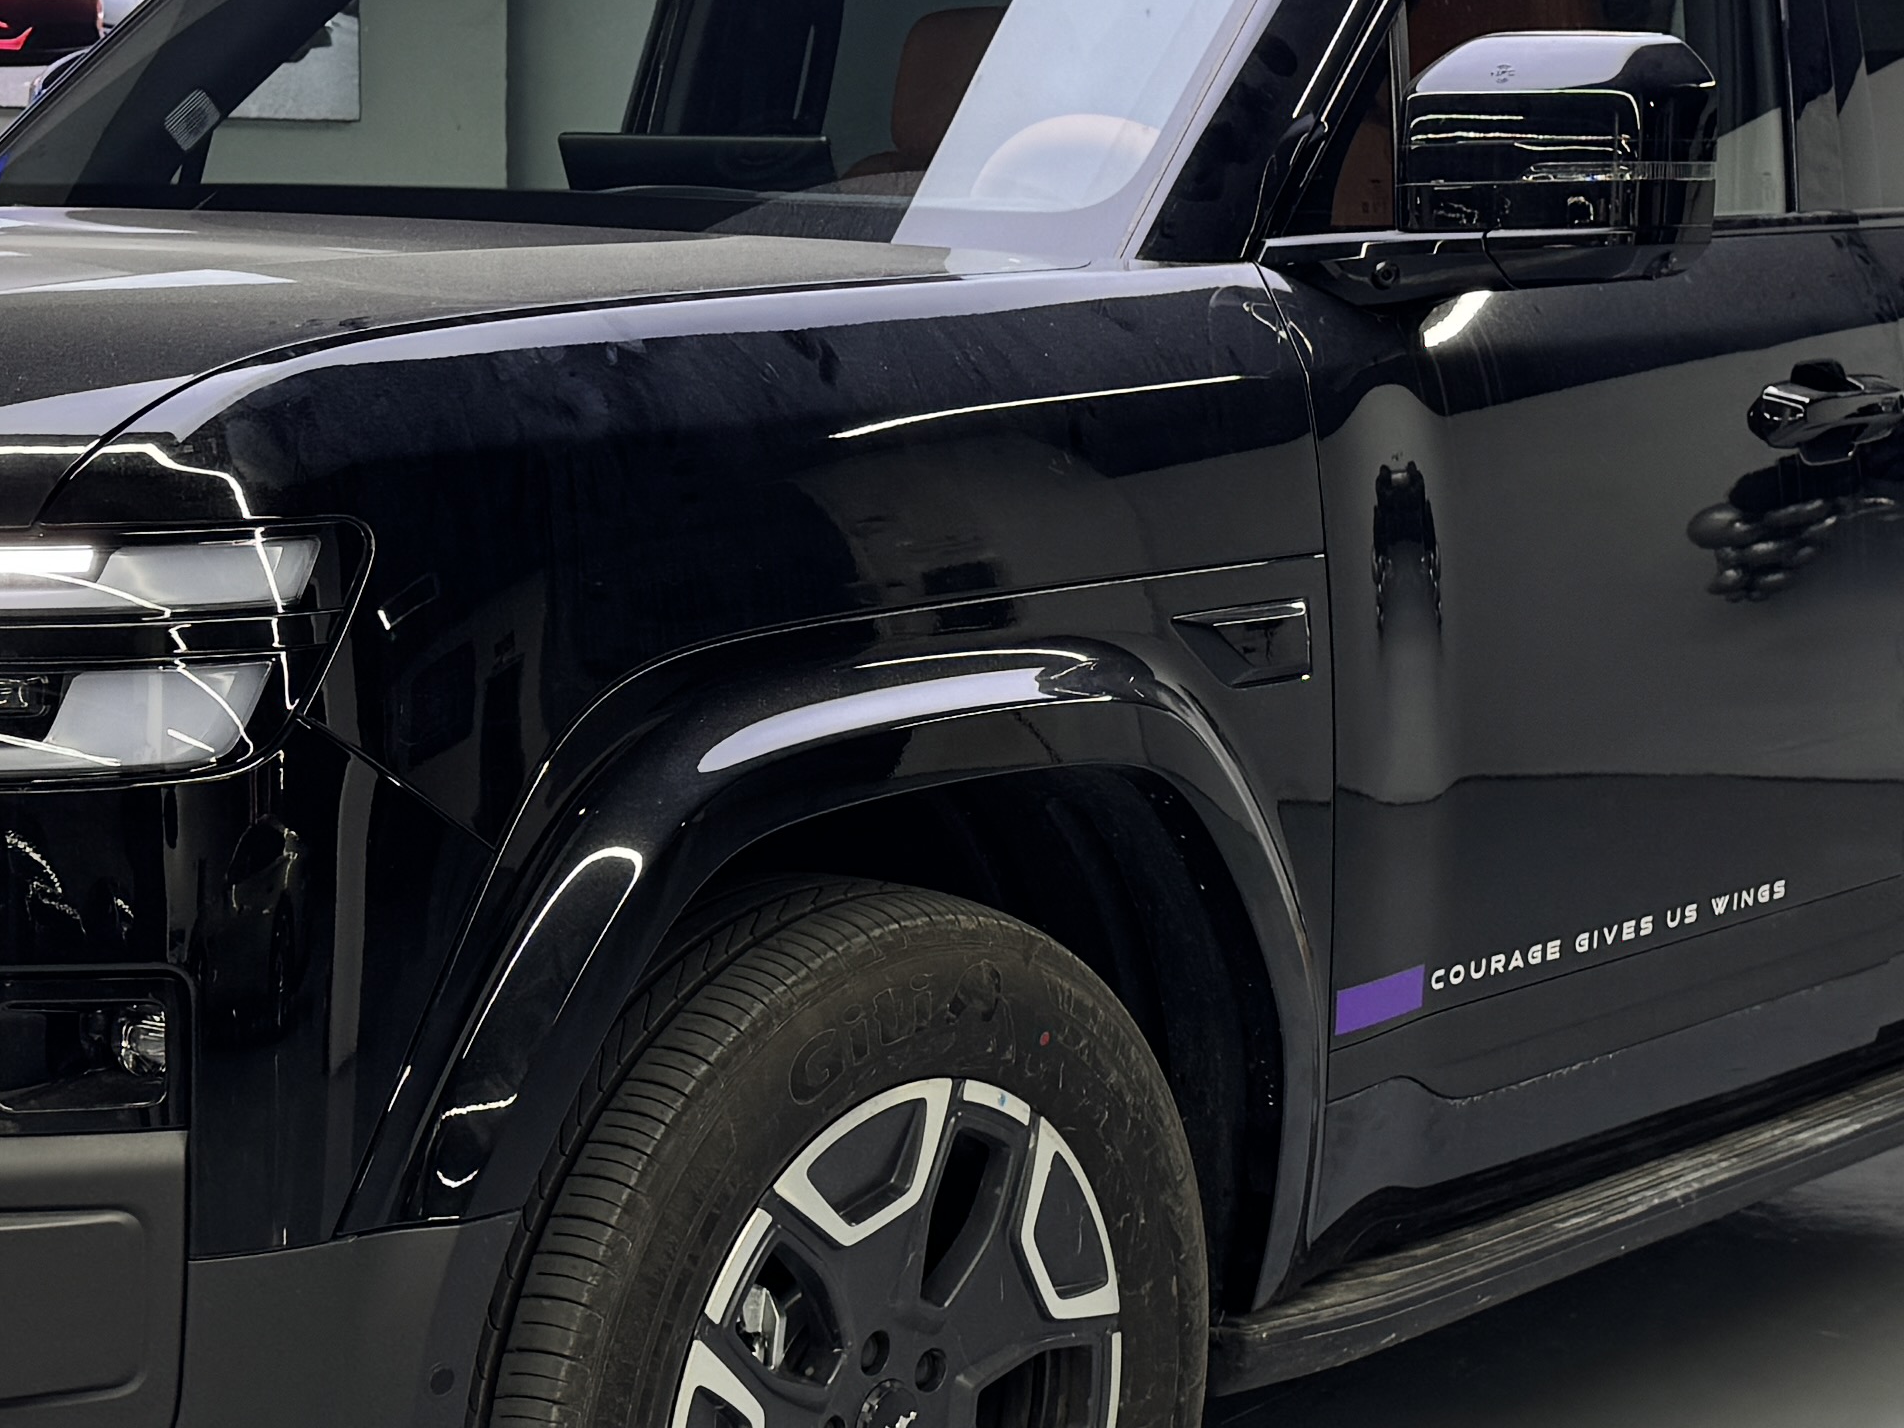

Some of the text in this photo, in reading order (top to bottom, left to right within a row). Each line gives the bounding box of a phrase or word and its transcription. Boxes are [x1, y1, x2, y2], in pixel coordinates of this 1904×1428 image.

[1430, 879, 1786, 991] COURAGE GIVES US WINGS
